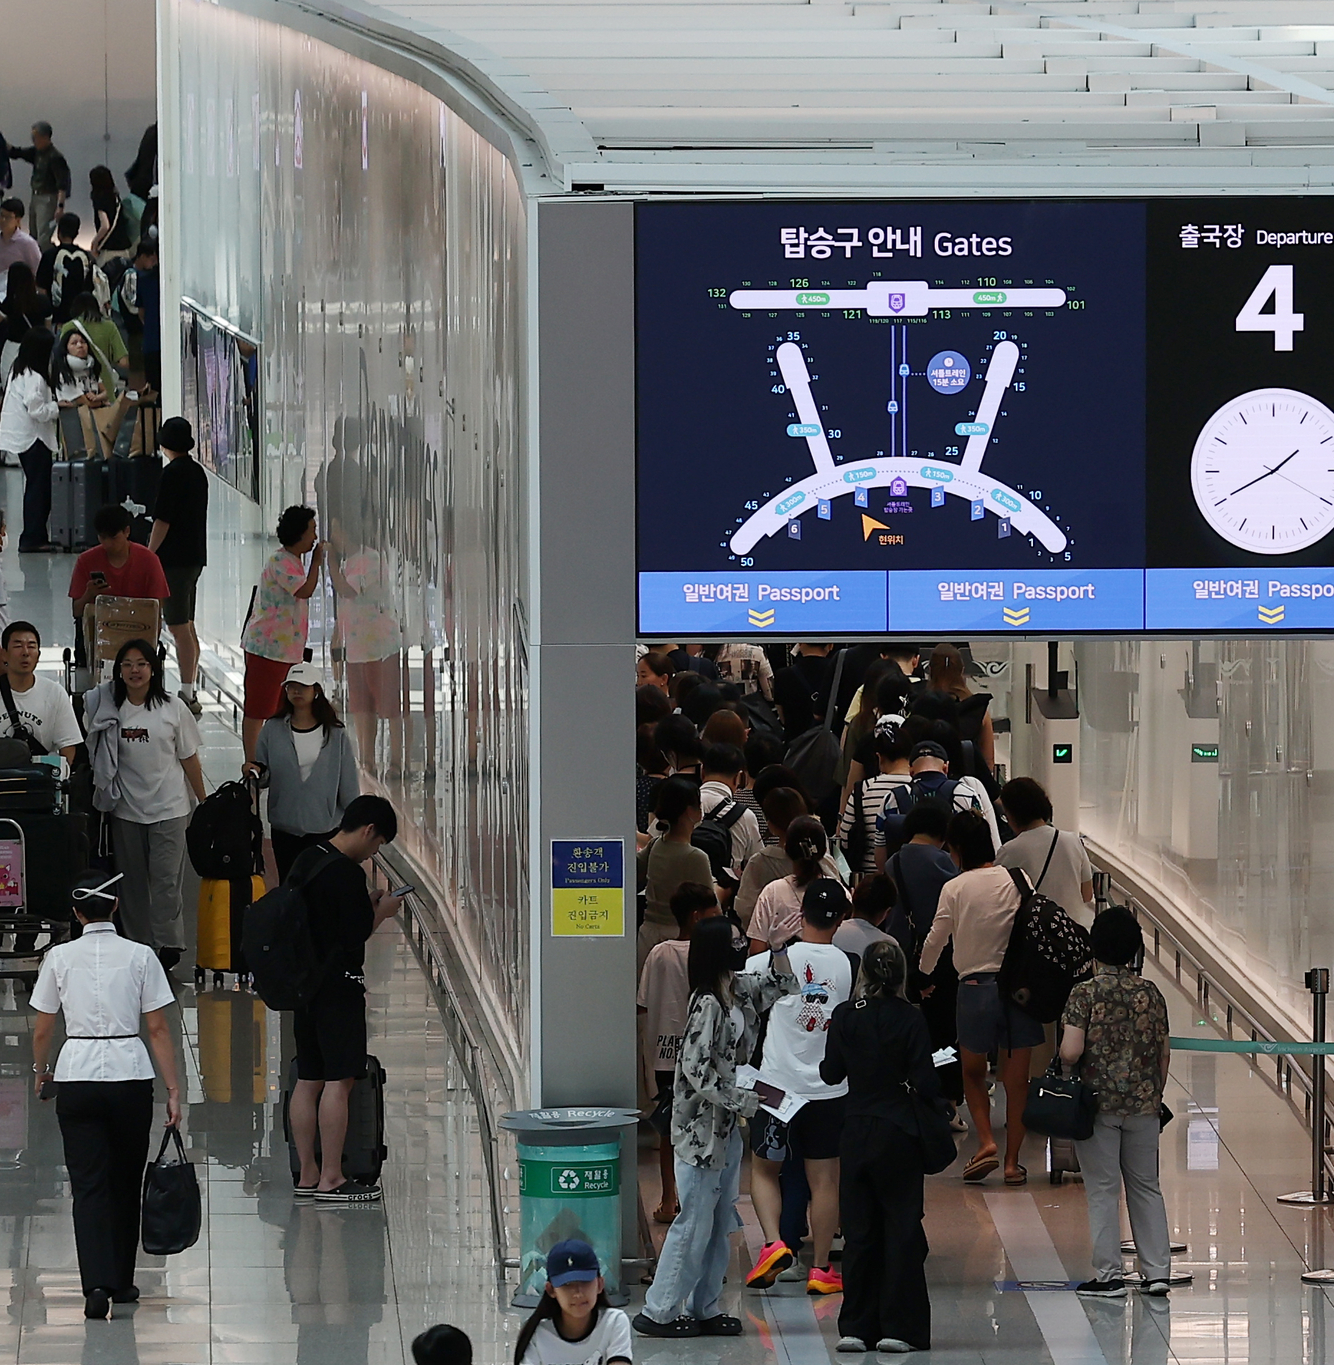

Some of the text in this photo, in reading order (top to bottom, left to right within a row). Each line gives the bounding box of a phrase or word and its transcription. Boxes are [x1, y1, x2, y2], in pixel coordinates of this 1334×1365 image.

[1178, 223, 1244, 249] 출국장
[1256, 227, 1331, 247] Departure
[779, 226, 1012, 258] 탑승구 안내 Gates
[790, 279, 809, 288] 126
[977, 278, 996, 286] 110
[707, 289, 726, 298] 132
[1067, 301, 1085, 310] 101
[1234, 264, 1305, 352] 4
[843, 310, 861, 319] 121
[933, 310, 951, 319] 113
[787, 332, 800, 340] 35
[993, 331, 1006, 340] 20
[933, 378, 966, 386] 15분 소요
[771, 385, 785, 394] 40
[1013, 383, 1026, 391] 15
[828, 430, 841, 438] 30
[945, 447, 958, 455] 25
[855, 470, 873, 478] 150m
[933, 471, 950, 479] 150m
[858, 493, 865, 502] 4
[934, 493, 941, 501] 3
[1029, 491, 1041, 500] 10
[745, 501, 758, 510] 45
[821, 505, 828, 514] 5
[974, 505, 981, 514] 2
[791, 524, 797, 533] 6
[1002, 523, 1007, 532] 1
[878, 535, 904, 545] 현위치
[1029, 538, 1034, 547] 1
[1064, 552, 1071, 561] 5
[740, 558, 754, 567] 50
[683, 582, 840, 605] 일반여권 Passport
[937, 580, 1095, 604] 일반여권 Passport
[1192, 578, 1260, 601] 일반여권
[573, 847, 602, 859] 환송객
[567, 862, 609, 873] 진입불가
[578, 895, 598, 905] 카트
[568, 910, 608, 921] 진입금지
[568, 1110, 615, 1118] Recycle
[585, 1169, 608, 1180] 재활용
[585, 1181, 608, 1190] Recycle
